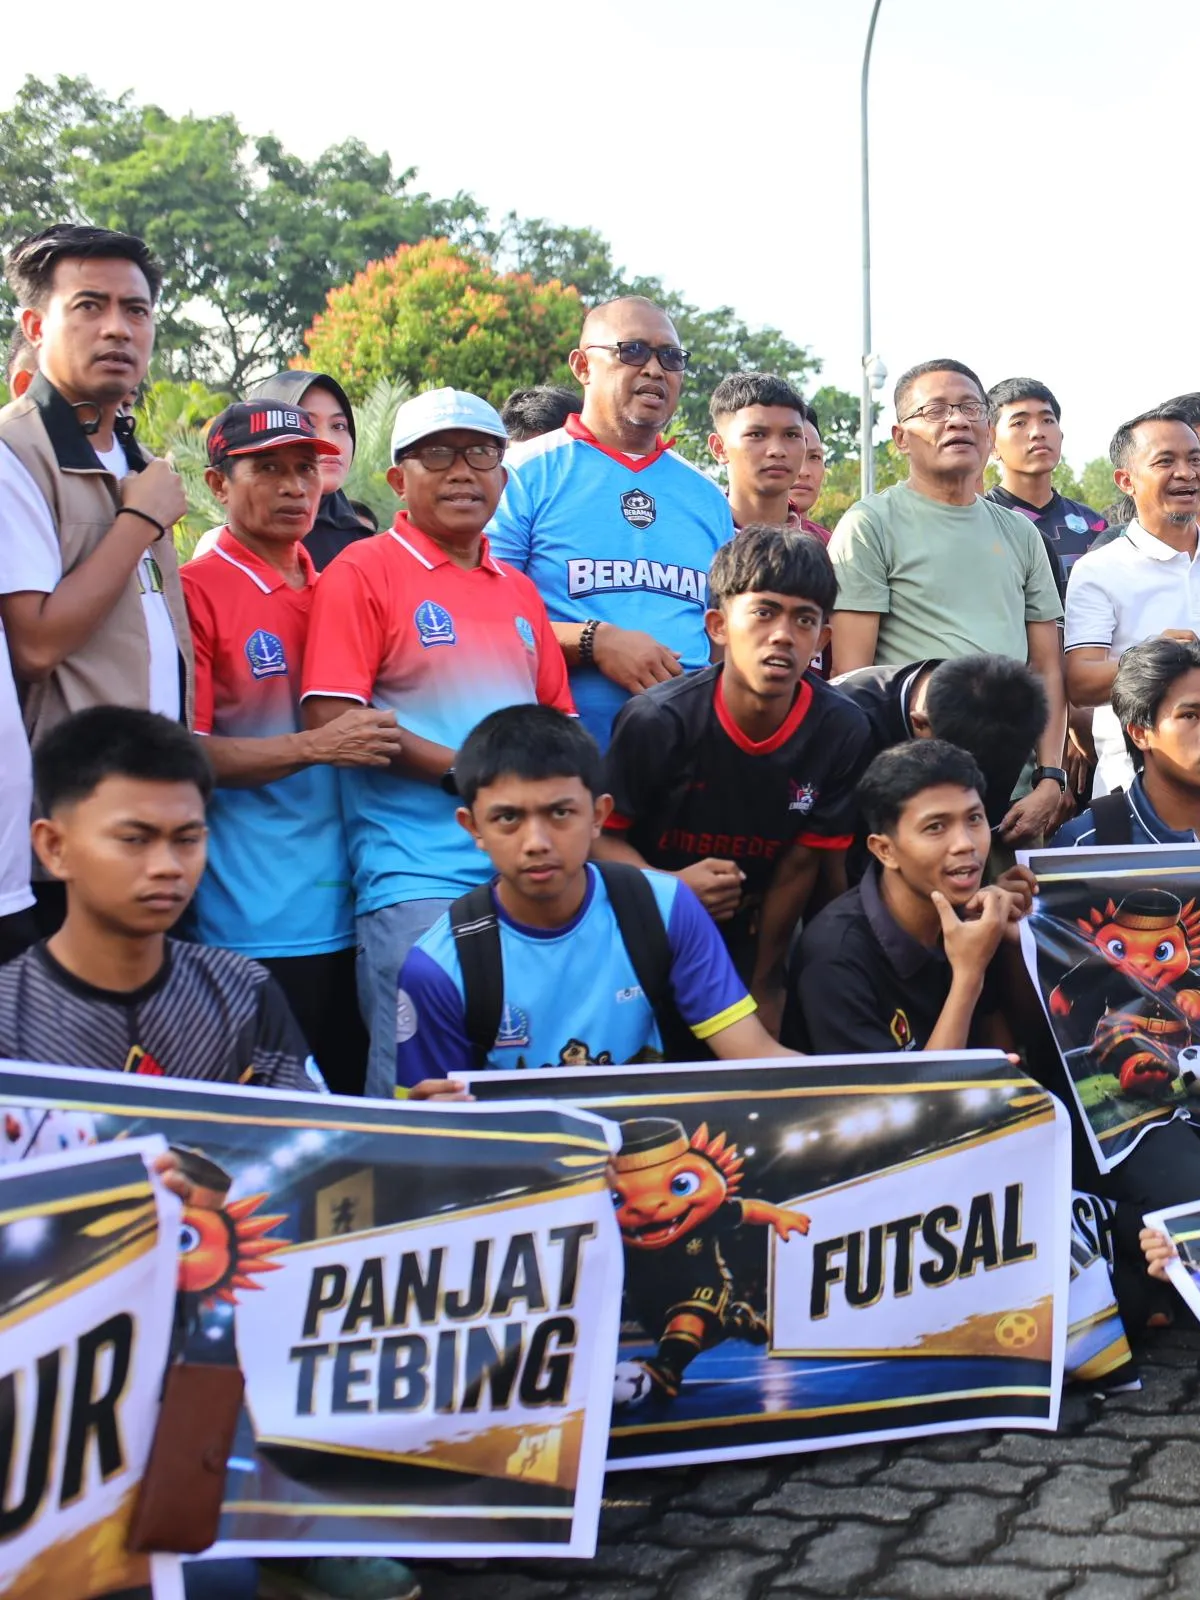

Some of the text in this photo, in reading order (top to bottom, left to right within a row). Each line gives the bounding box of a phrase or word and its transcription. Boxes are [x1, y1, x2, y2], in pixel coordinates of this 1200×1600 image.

[301, 1221, 598, 1339] PANJAT
[692, 1287, 714, 1300] 10
[810, 1183, 1036, 1321] FUTSAL
[289, 1315, 578, 1416] TEBING
